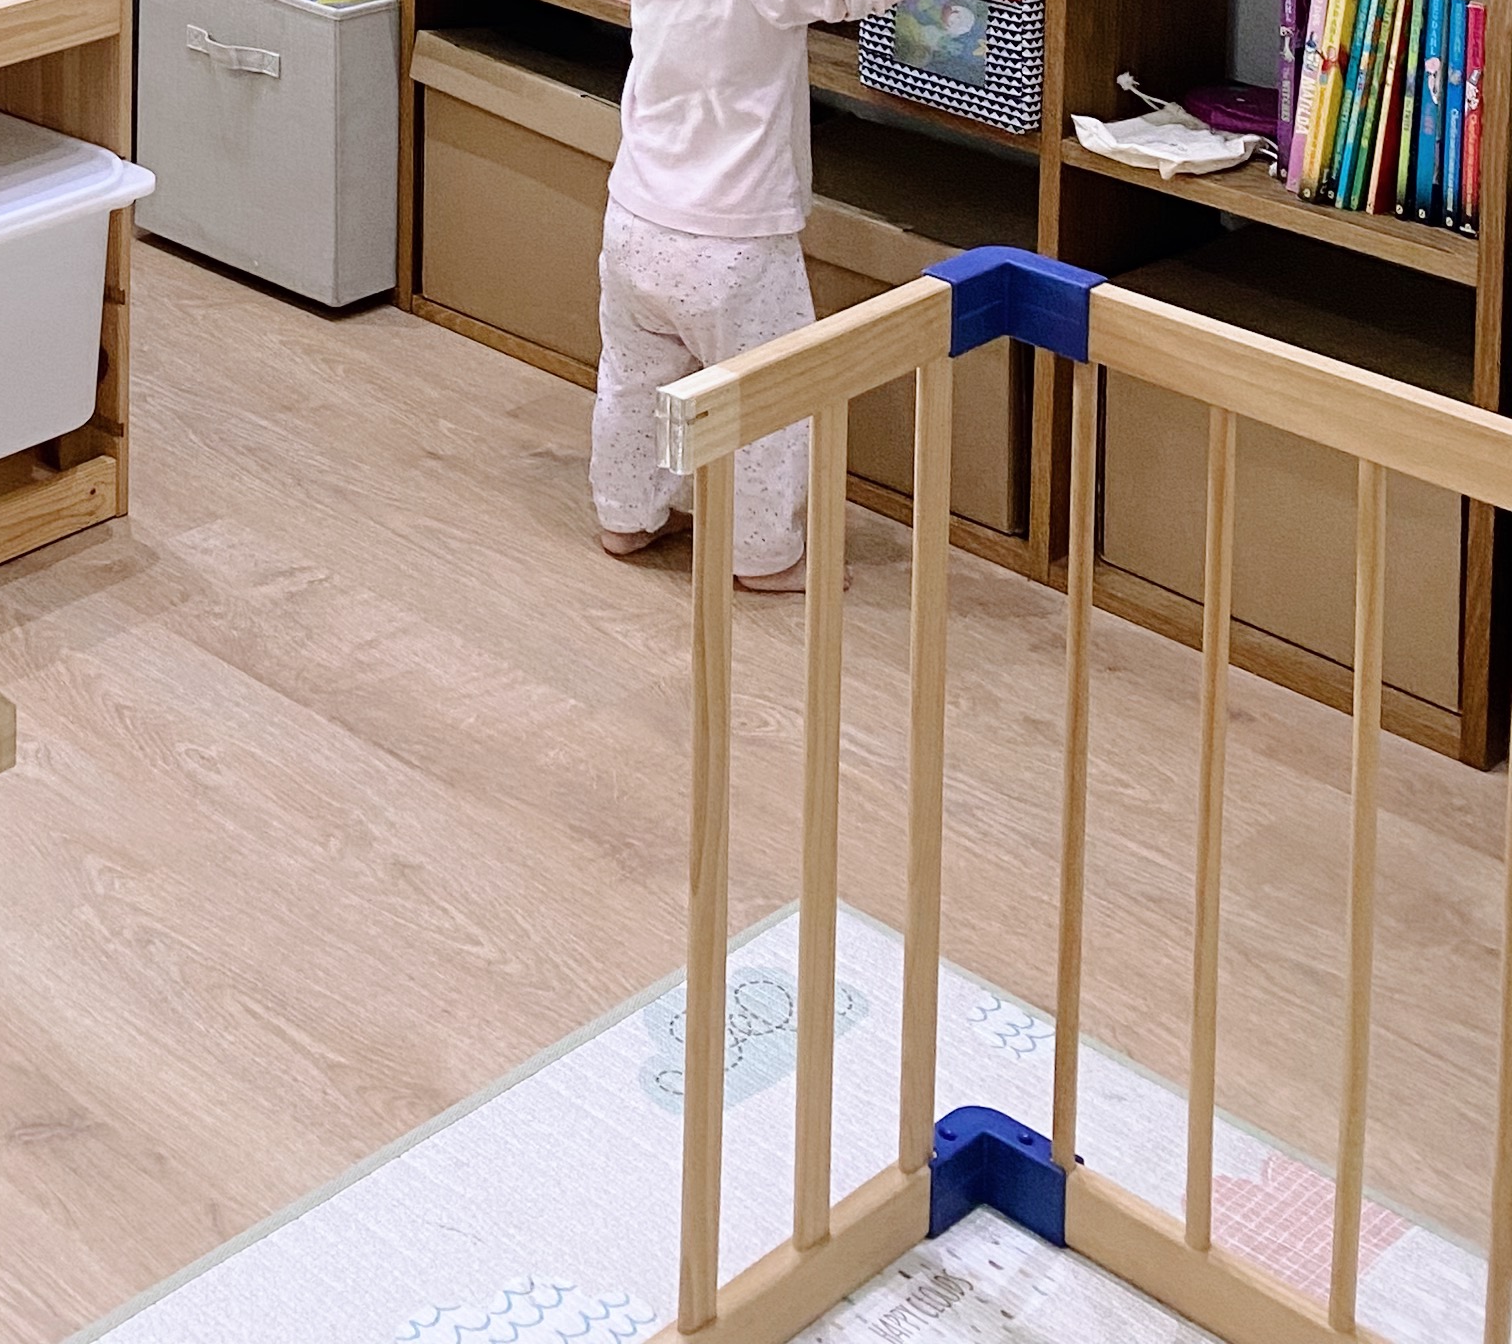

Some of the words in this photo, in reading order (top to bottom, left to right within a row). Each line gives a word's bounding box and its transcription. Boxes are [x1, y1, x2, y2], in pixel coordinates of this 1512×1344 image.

[1294, 75, 1316, 135] MATILDA
[1448, 107, 1460, 141] Charlie
[868, 1304, 930, 1344] HAPPY
[906, 1268, 974, 1318] CLOUDS
